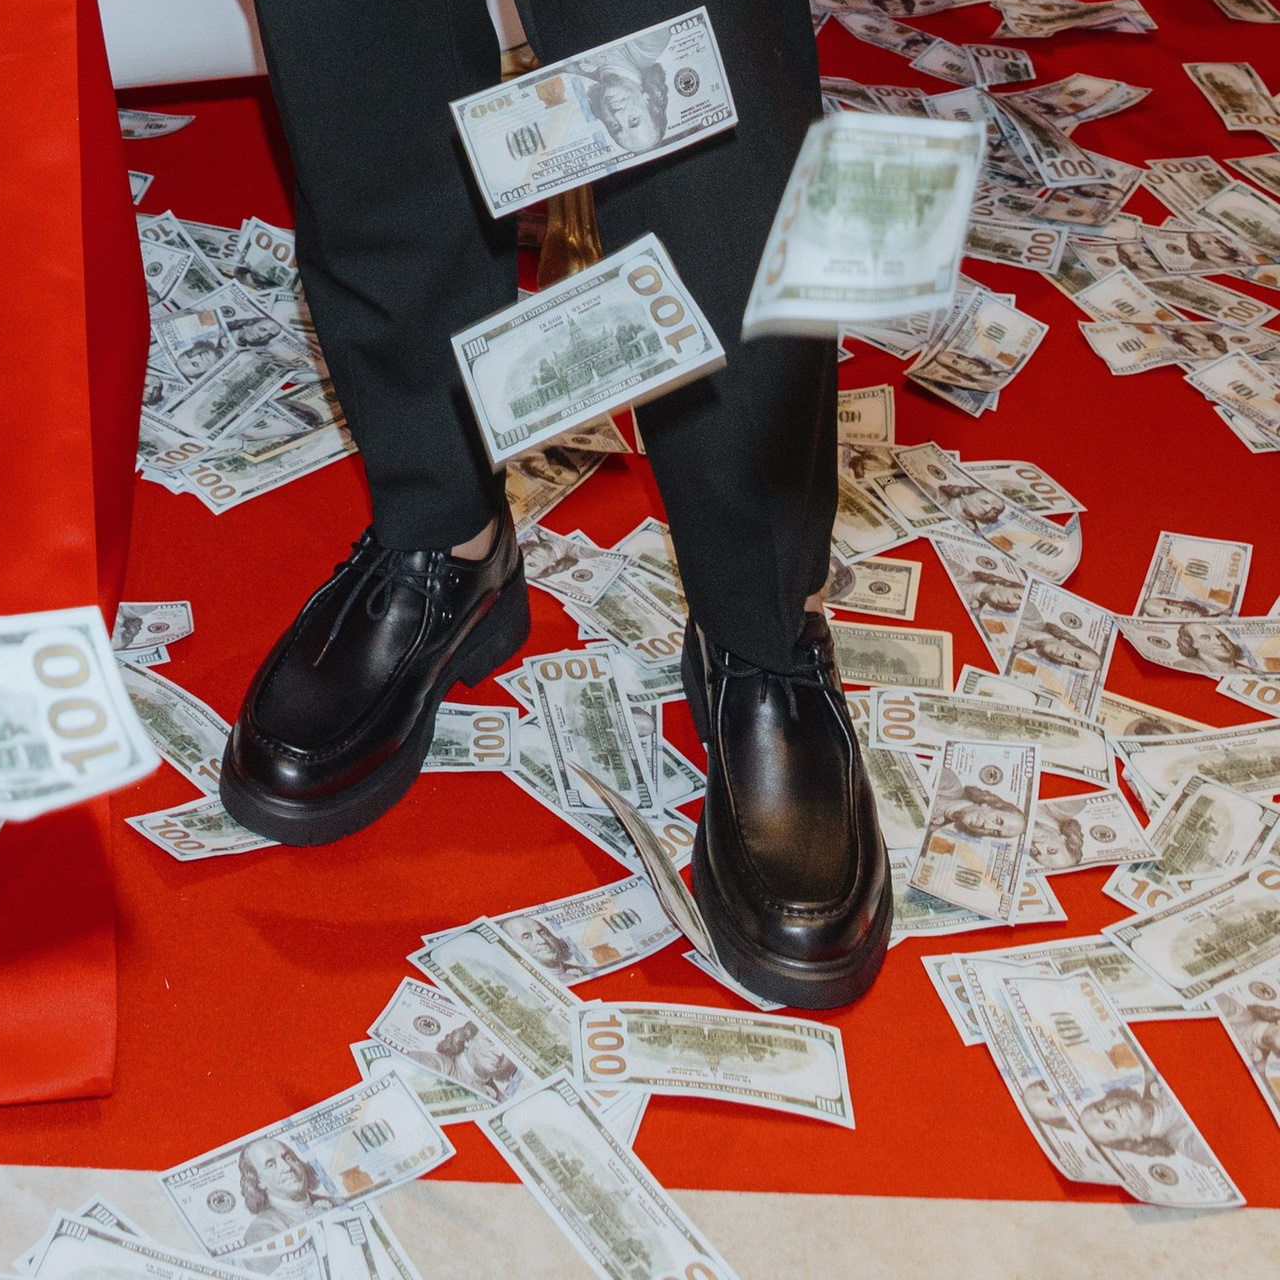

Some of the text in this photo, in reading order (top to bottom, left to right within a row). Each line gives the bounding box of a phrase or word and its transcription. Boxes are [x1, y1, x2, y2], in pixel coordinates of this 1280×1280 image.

[669, 18, 703, 35] 100
[975, 46, 1020, 60] 100
[470, 95, 513, 118] 100
[701, 109, 734, 127] 100
[506, 122, 547, 160] 100
[1046, 157, 1097, 179] 100
[1160, 161, 1211, 175] 100
[500, 183, 534, 203] 100
[1023, 232, 1054, 266] 100
[627, 265, 697, 354] 100
[1221, 300, 1264, 324] 100
[463, 337, 489, 361] 100
[153, 442, 205, 467] 100
[188, 463, 236, 501] 100
[1016, 467, 1069, 513] 100
[1185, 558, 1211, 580] 100
[1227, 551, 1242, 579] 100
[540, 657, 608, 681] 100
[1241, 678, 1280, 704] 10
[33, 645, 119, 775] 100
[883, 695, 916, 740] 100
[472, 716, 505, 763] 100
[944, 743, 954, 769] 100
[1025, 749, 1036, 778] 100
[149, 818, 207, 853] 100
[609, 881, 638, 897] 100
[1130, 877, 1173, 908] 10
[998, 892, 1010, 916] 100
[476, 923, 500, 944] 100
[602, 908, 642, 934] 100
[1117, 926, 1141, 941] 100
[1080, 981, 1110, 1023] 100
[365, 1046, 391, 1059] 100
[586, 1014, 626, 1075] 100
[360, 1078, 391, 1101] 100
[554, 1079, 580, 1106] 100
[816, 1096, 844, 1117] 100
[352, 1117, 396, 1153] 100
[394, 1146, 436, 1174] 100
[169, 1166, 199, 1183] 100
[60, 1221, 89, 1241] 100
